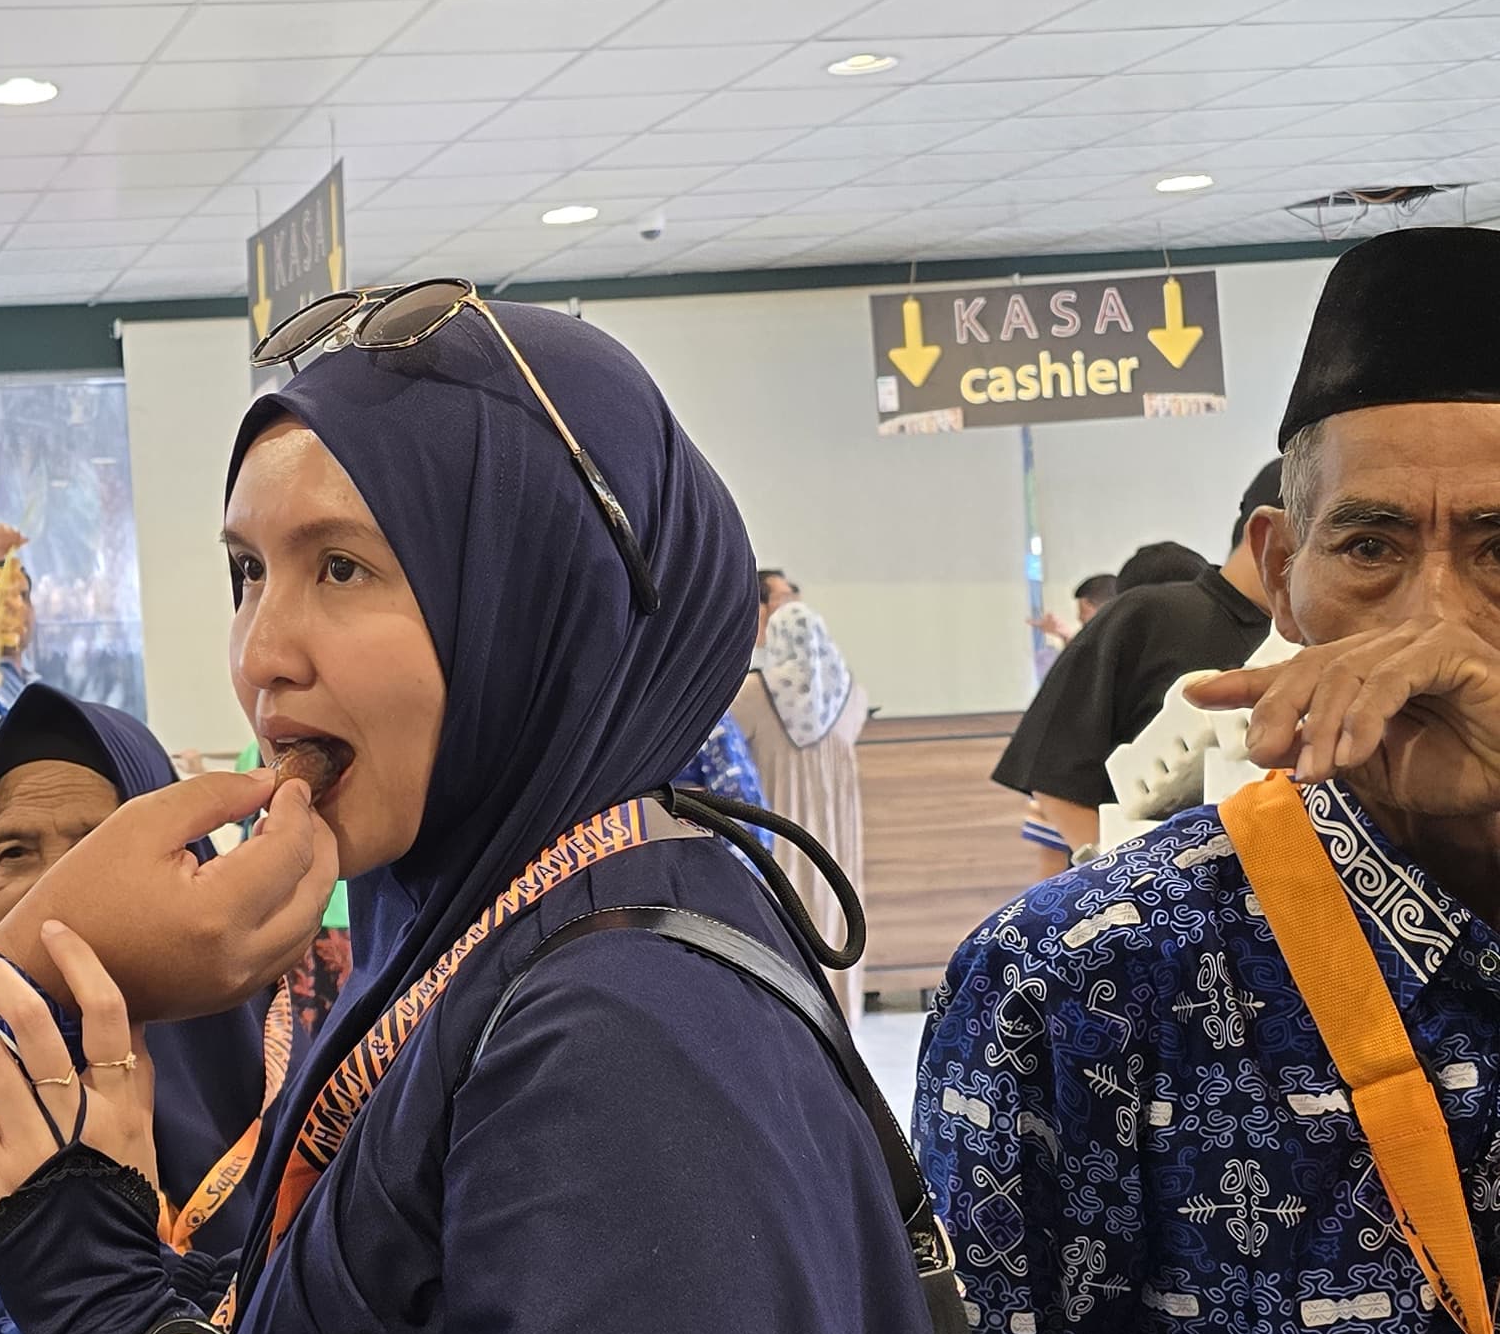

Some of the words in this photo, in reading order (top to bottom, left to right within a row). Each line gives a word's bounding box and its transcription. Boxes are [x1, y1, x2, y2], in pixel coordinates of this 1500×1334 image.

[274, 199, 325, 291] KASA
[953, 286, 1133, 345] KASA
[960, 349, 1139, 405] cashier
[312, 1066, 366, 1149] HAJJ
[371, 1036, 388, 1055] &
[400, 923, 485, 1017] UMRAH
[501, 815, 631, 912] TRAVELS
[205, 1155, 248, 1211] Safari
